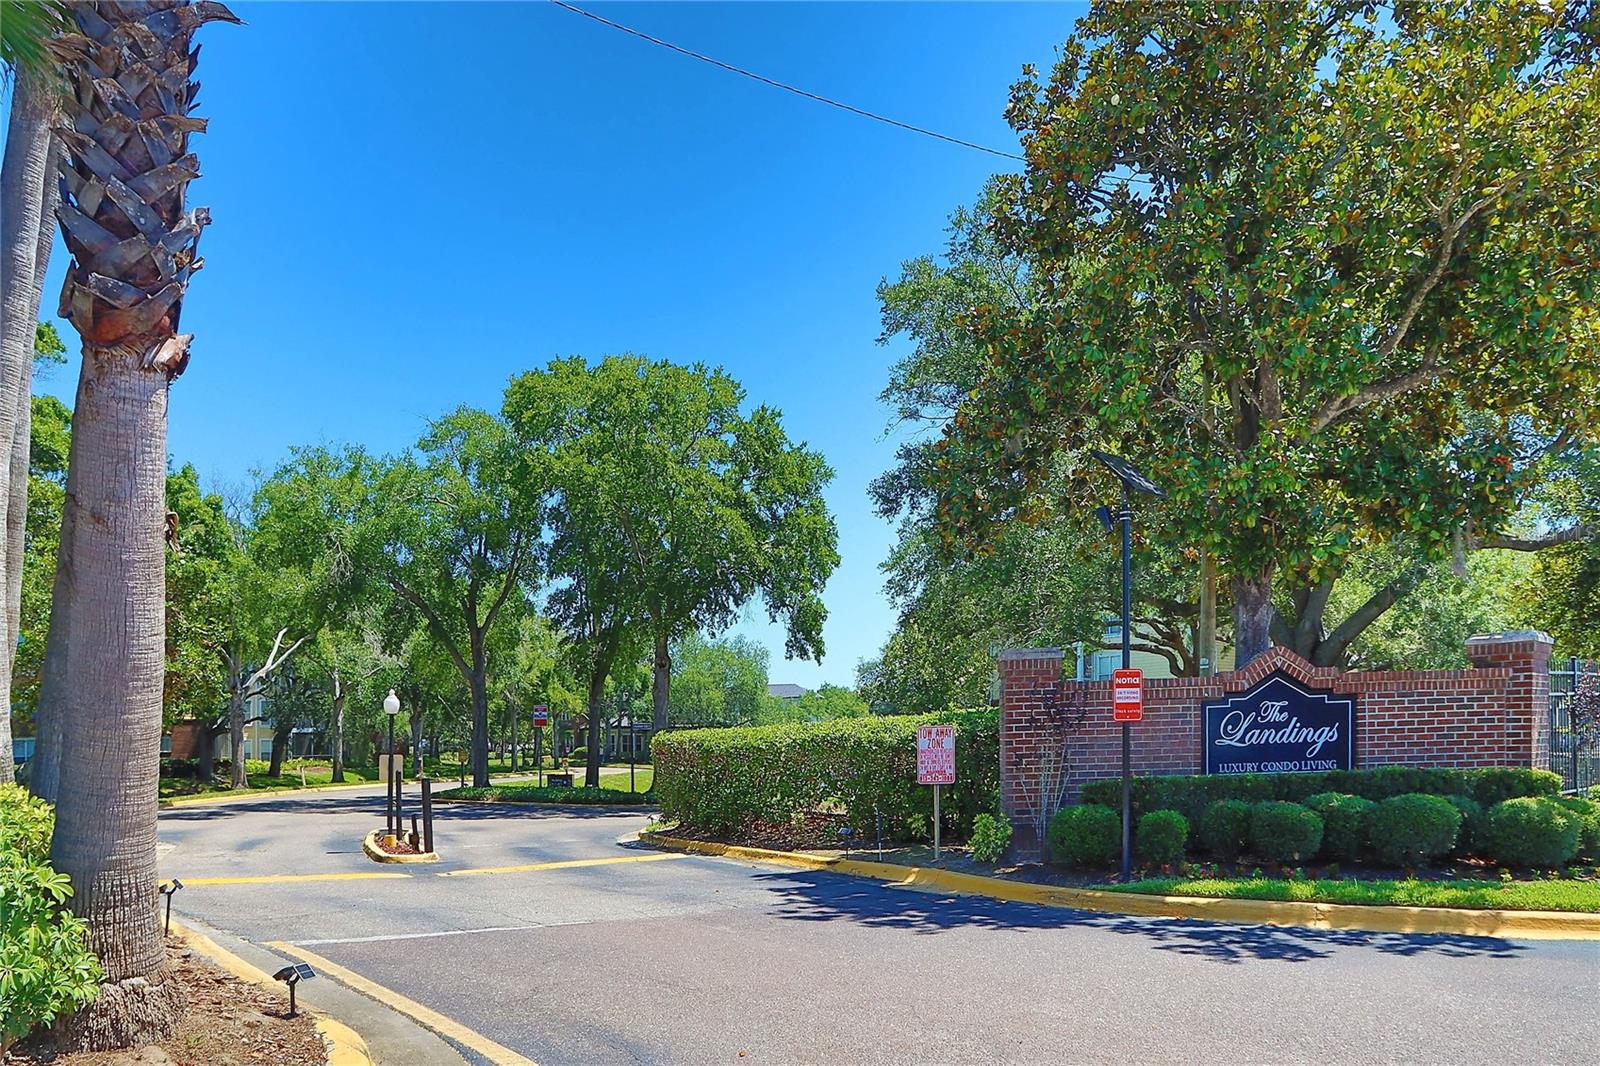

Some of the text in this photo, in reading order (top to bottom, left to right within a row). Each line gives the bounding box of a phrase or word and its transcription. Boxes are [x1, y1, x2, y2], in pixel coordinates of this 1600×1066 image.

[1257, 700, 1289, 723] The
[919, 728, 952, 739] TOW AWAY
[1214, 710, 1339, 758] Landings
[927, 738, 945, 749] ZONE
[1218, 759, 1337, 773] LUXURY CONDO LIVING
